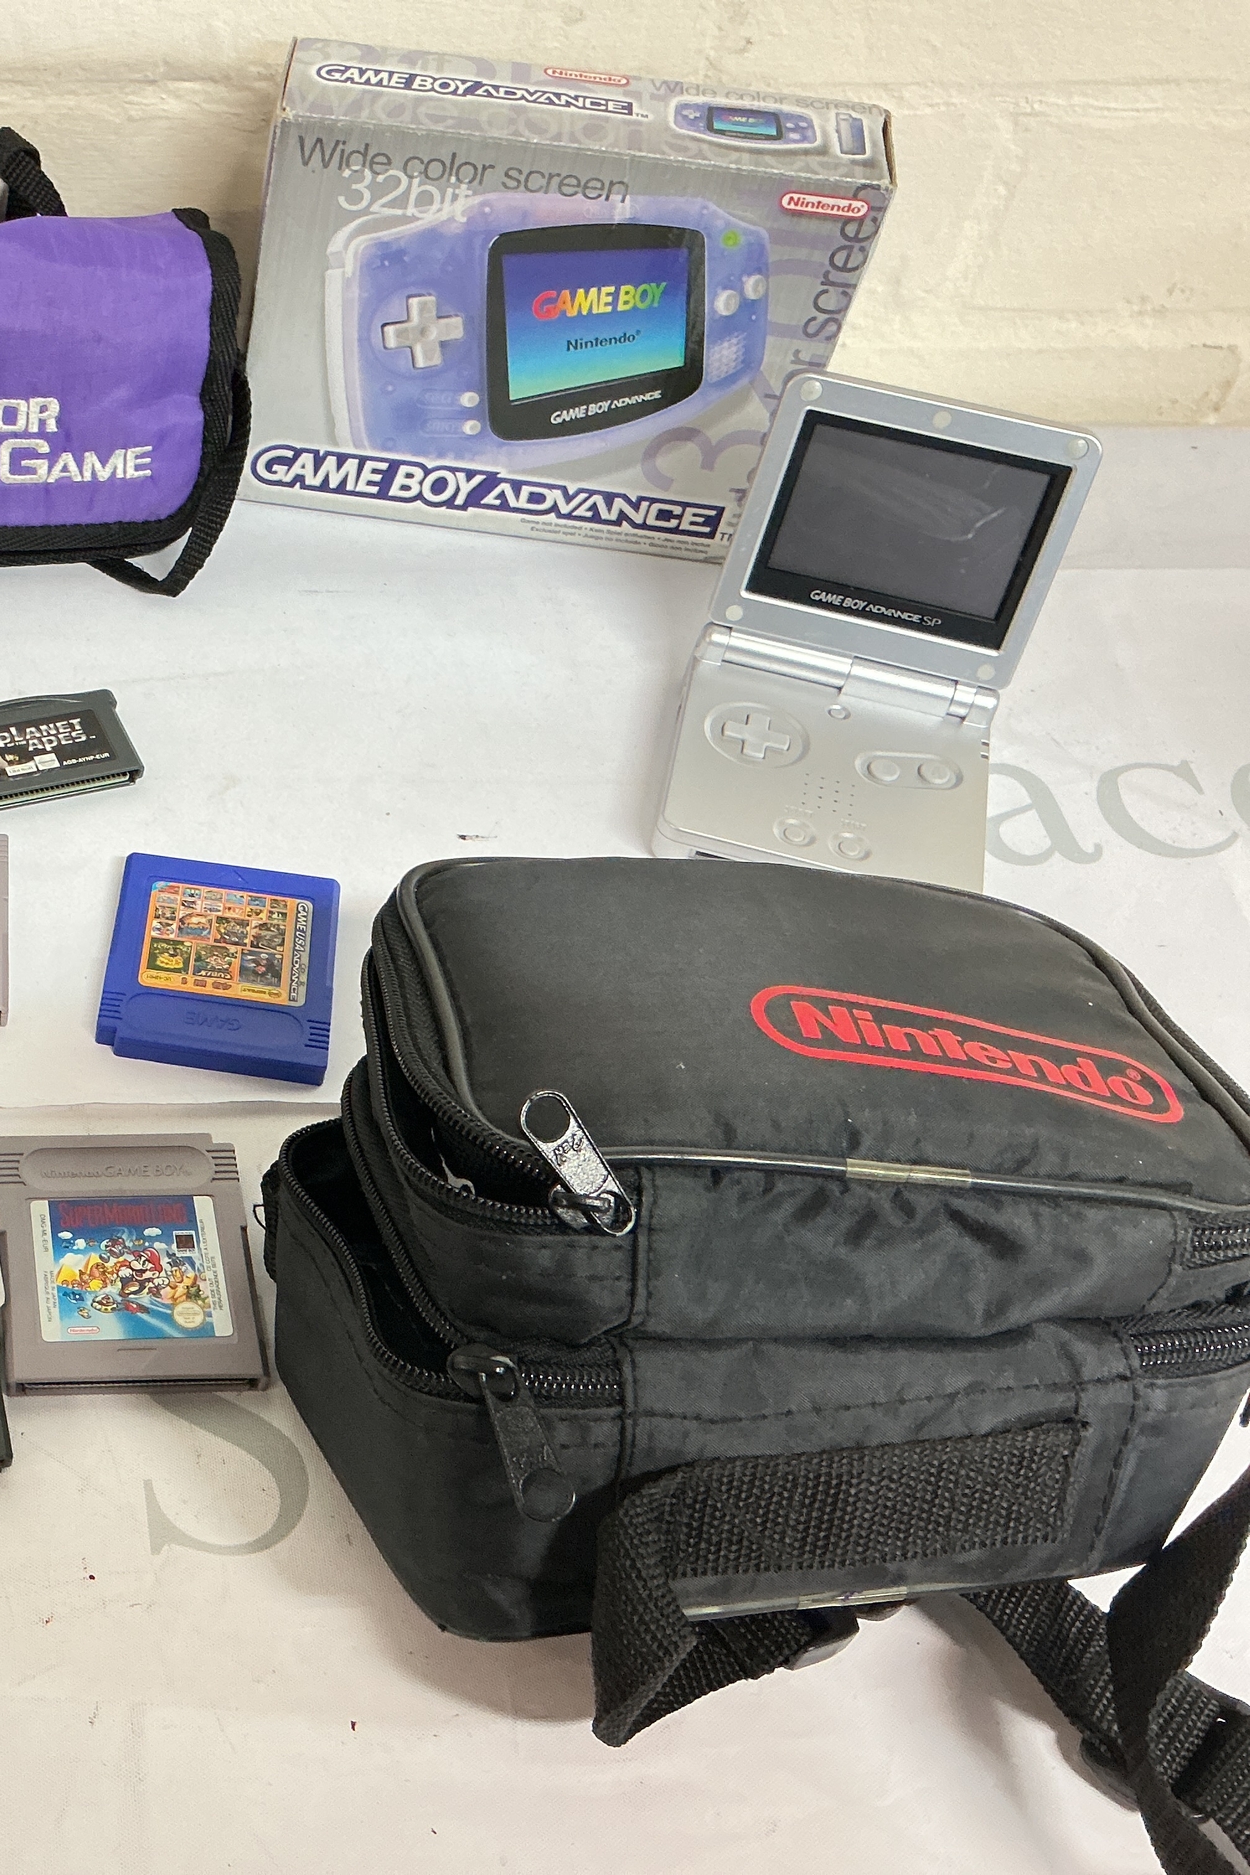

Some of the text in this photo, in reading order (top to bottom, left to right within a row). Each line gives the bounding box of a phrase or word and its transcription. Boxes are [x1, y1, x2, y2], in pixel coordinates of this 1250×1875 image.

[317, 64, 402, 88] GAME
[411, 75, 474, 95] BOY
[474, 84, 631, 114] ADVANCE
[550, 67, 624, 84] Nintendo
[651, 79, 718, 98] Wide
[297, 134, 630, 204] Wide color screen
[337, 165, 474, 224] 32bit
[786, 195, 865, 215] Nintendo
[532, 282, 667, 320] GAME BOY
[550, 389, 662, 425] GAME BOY ADVANCE
[255, 447, 719, 535] GAME BOY ADVANCE
[809, 588, 943, 629] GAME BOY ADVANCE SP
[28, 730, 88, 751] APES
[789, 1000, 1154, 1107] Nintendo
[103, 1164, 150, 1178] GAME
[155, 1163, 184, 1177] BOY
